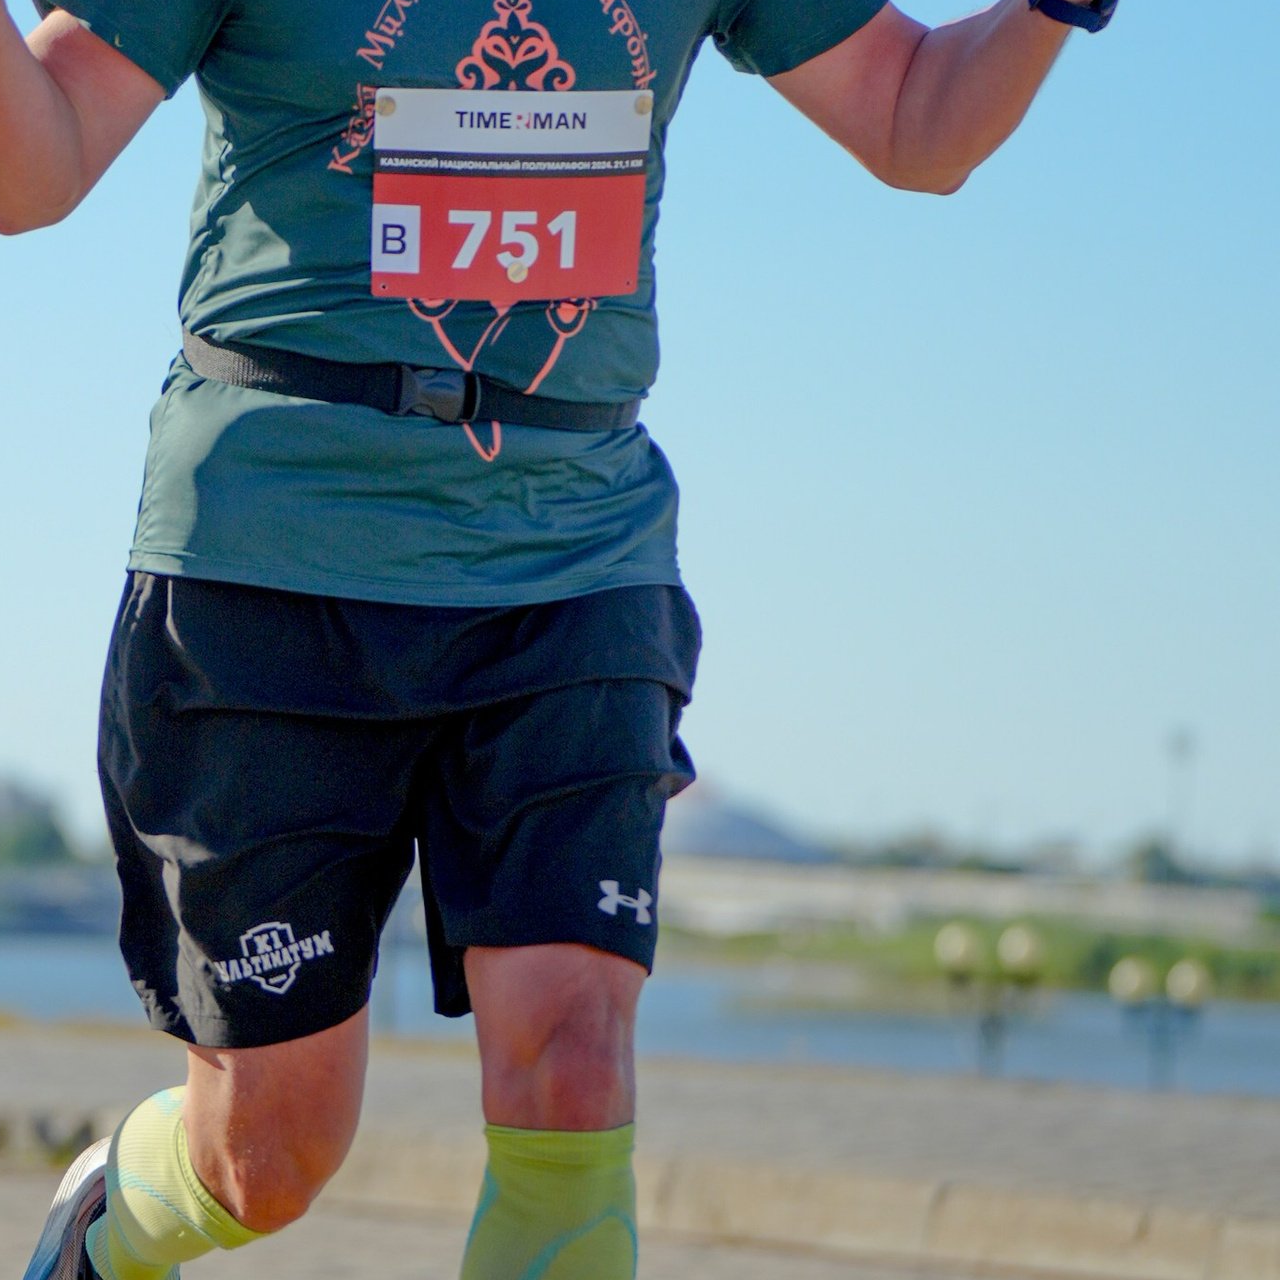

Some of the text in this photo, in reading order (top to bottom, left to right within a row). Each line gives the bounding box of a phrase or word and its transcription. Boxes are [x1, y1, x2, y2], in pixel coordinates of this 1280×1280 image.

[380, 157, 438, 168] КАЗАНСКИЙ
[440, 157, 520, 170] НАЦИОНАЛЬНЫЙ
[522, 160, 590, 171] ПОЛУМАРАФОН
[448, 210, 577, 270] 751
[213, 930, 334, 982] УЛЬТИМАТУМ
